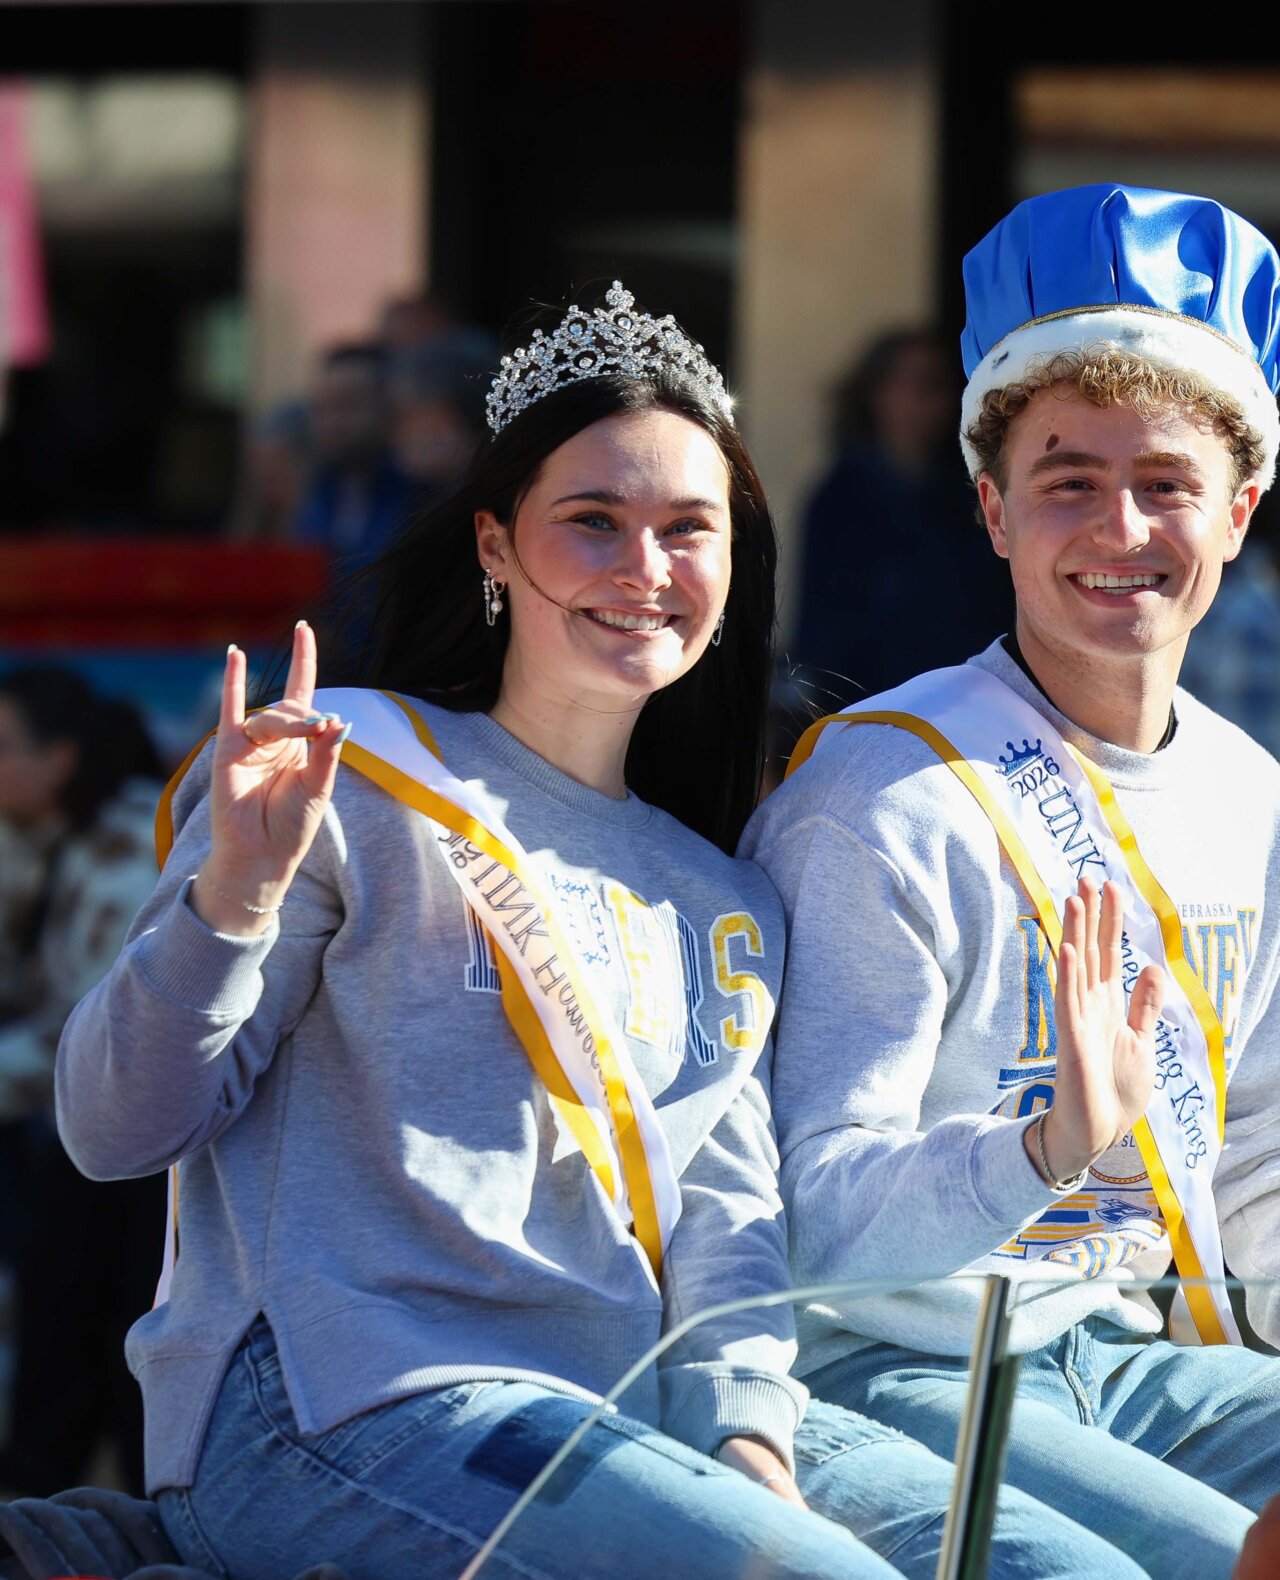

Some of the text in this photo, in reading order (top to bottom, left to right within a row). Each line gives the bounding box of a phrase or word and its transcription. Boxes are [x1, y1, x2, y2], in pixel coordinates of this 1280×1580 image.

[1011, 756, 1060, 798] 2026
[1177, 902, 1233, 919] EBRASKA
[1038, 786, 1107, 880] UNK
[1170, 1081, 1207, 1169] King
